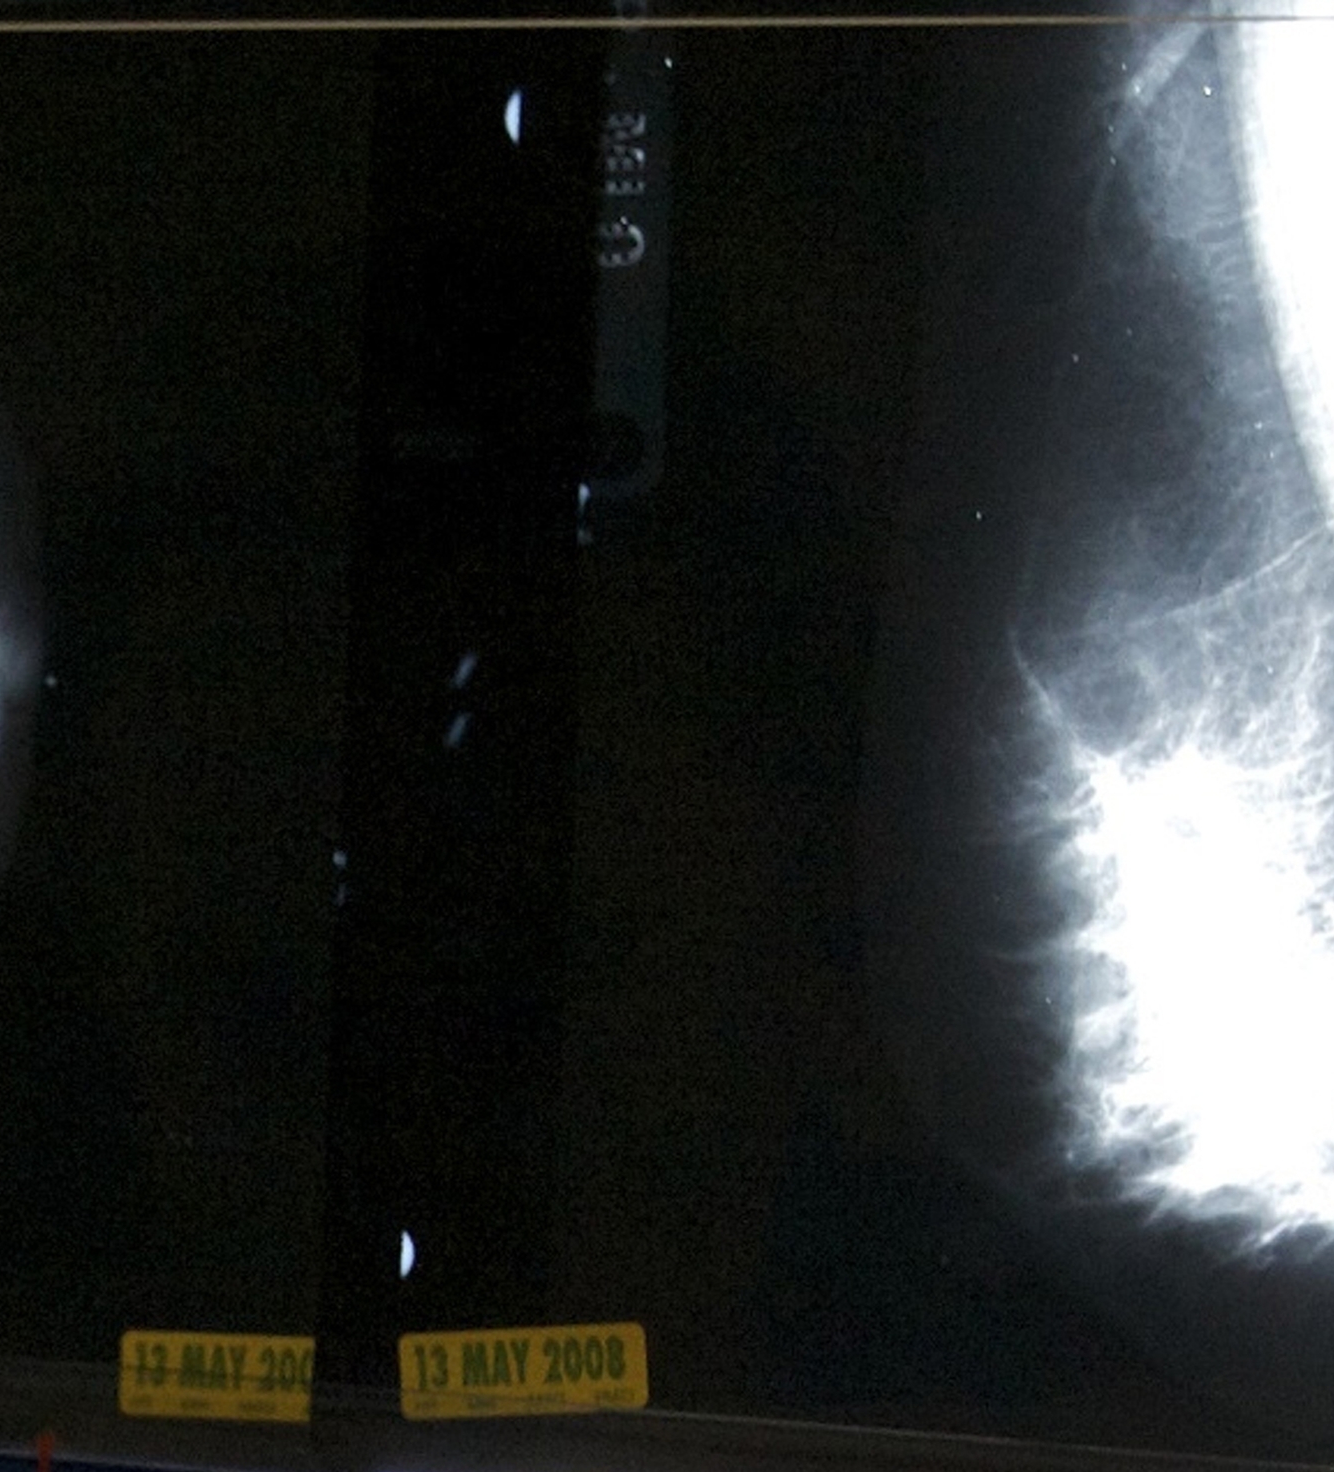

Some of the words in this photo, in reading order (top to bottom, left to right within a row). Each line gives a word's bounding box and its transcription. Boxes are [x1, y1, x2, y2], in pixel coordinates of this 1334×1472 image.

[135, 1342, 166, 1388] 13
[177, 1343, 248, 1391] MAY
[414, 1344, 448, 1391] 13
[461, 1338, 530, 1387] MAY
[543, 1334, 625, 1383] 2008
